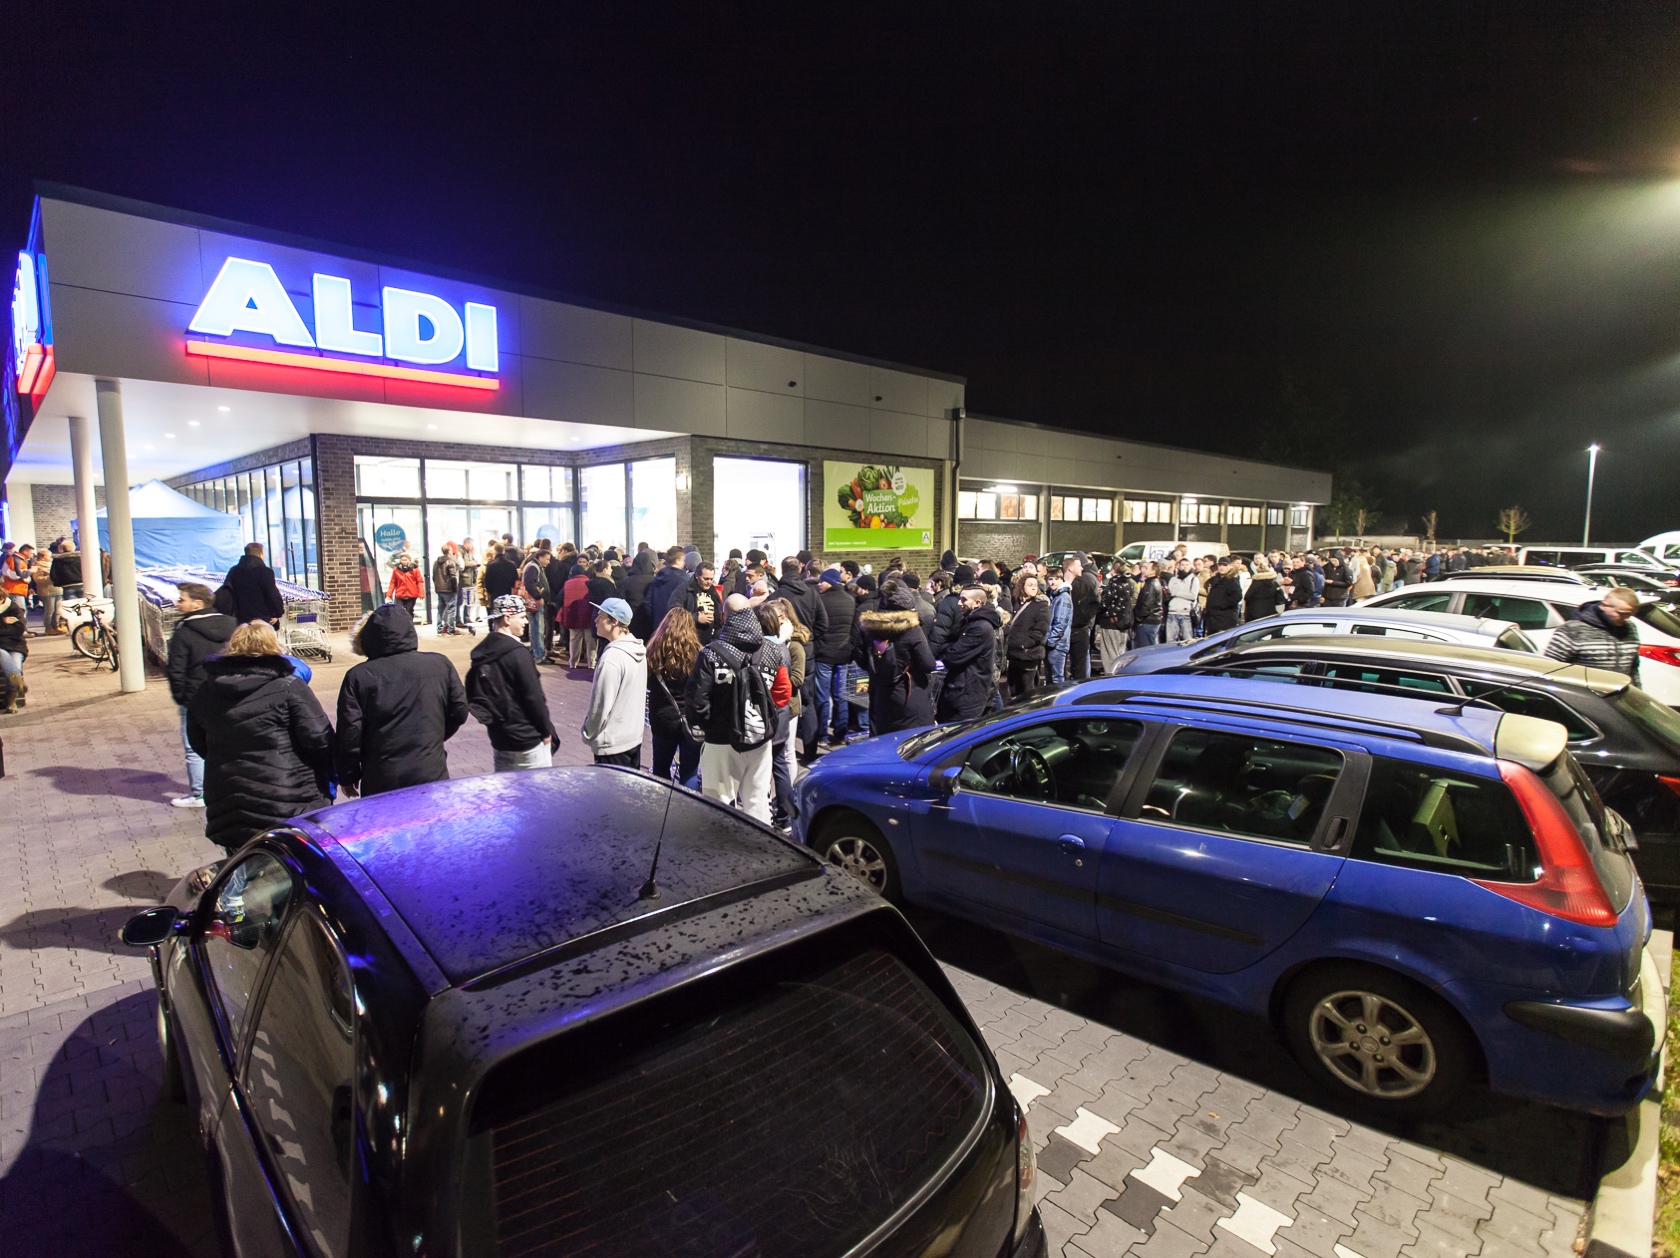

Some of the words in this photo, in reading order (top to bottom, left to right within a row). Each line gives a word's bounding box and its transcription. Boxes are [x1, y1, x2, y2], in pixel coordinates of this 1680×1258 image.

[188, 256, 498, 372] ALDI
[865, 493, 896, 502] Wochen-
[867, 502, 896, 513] Aktion
[380, 529, 401, 537] Hallo
